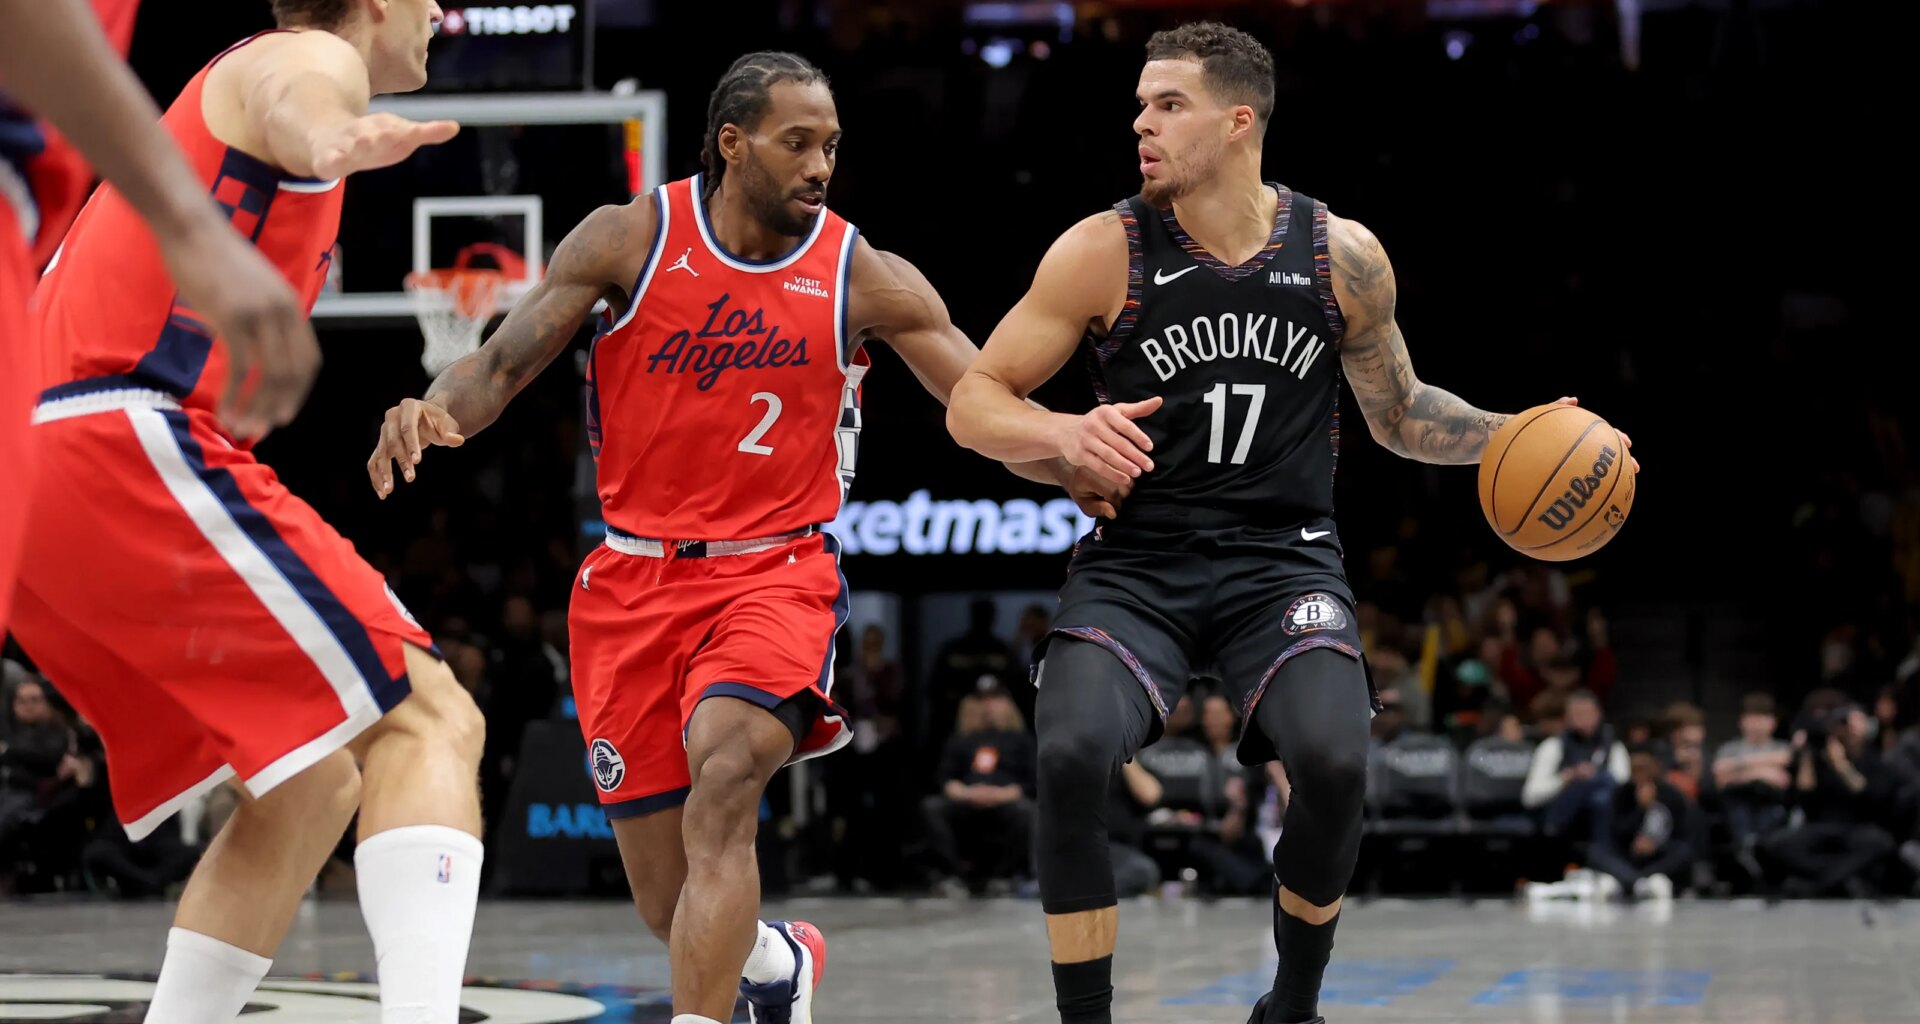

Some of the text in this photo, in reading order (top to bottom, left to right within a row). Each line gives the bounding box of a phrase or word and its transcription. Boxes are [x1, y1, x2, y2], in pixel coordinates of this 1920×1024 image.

[463, 5, 576, 35] TISSOT
[783, 281, 829, 298] RWANDA
[794, 276, 821, 288] VISIT
[1269, 271, 1311, 286] All In Won
[696, 292, 768, 339] Los
[646, 326, 813, 391] Angeles
[1140, 312, 1325, 382] BROOKLYN
[737, 391, 783, 456] 2
[1203, 382, 1266, 465] 17
[1537, 444, 1617, 531] Wilson
[1306, 604, 1320, 621] B
